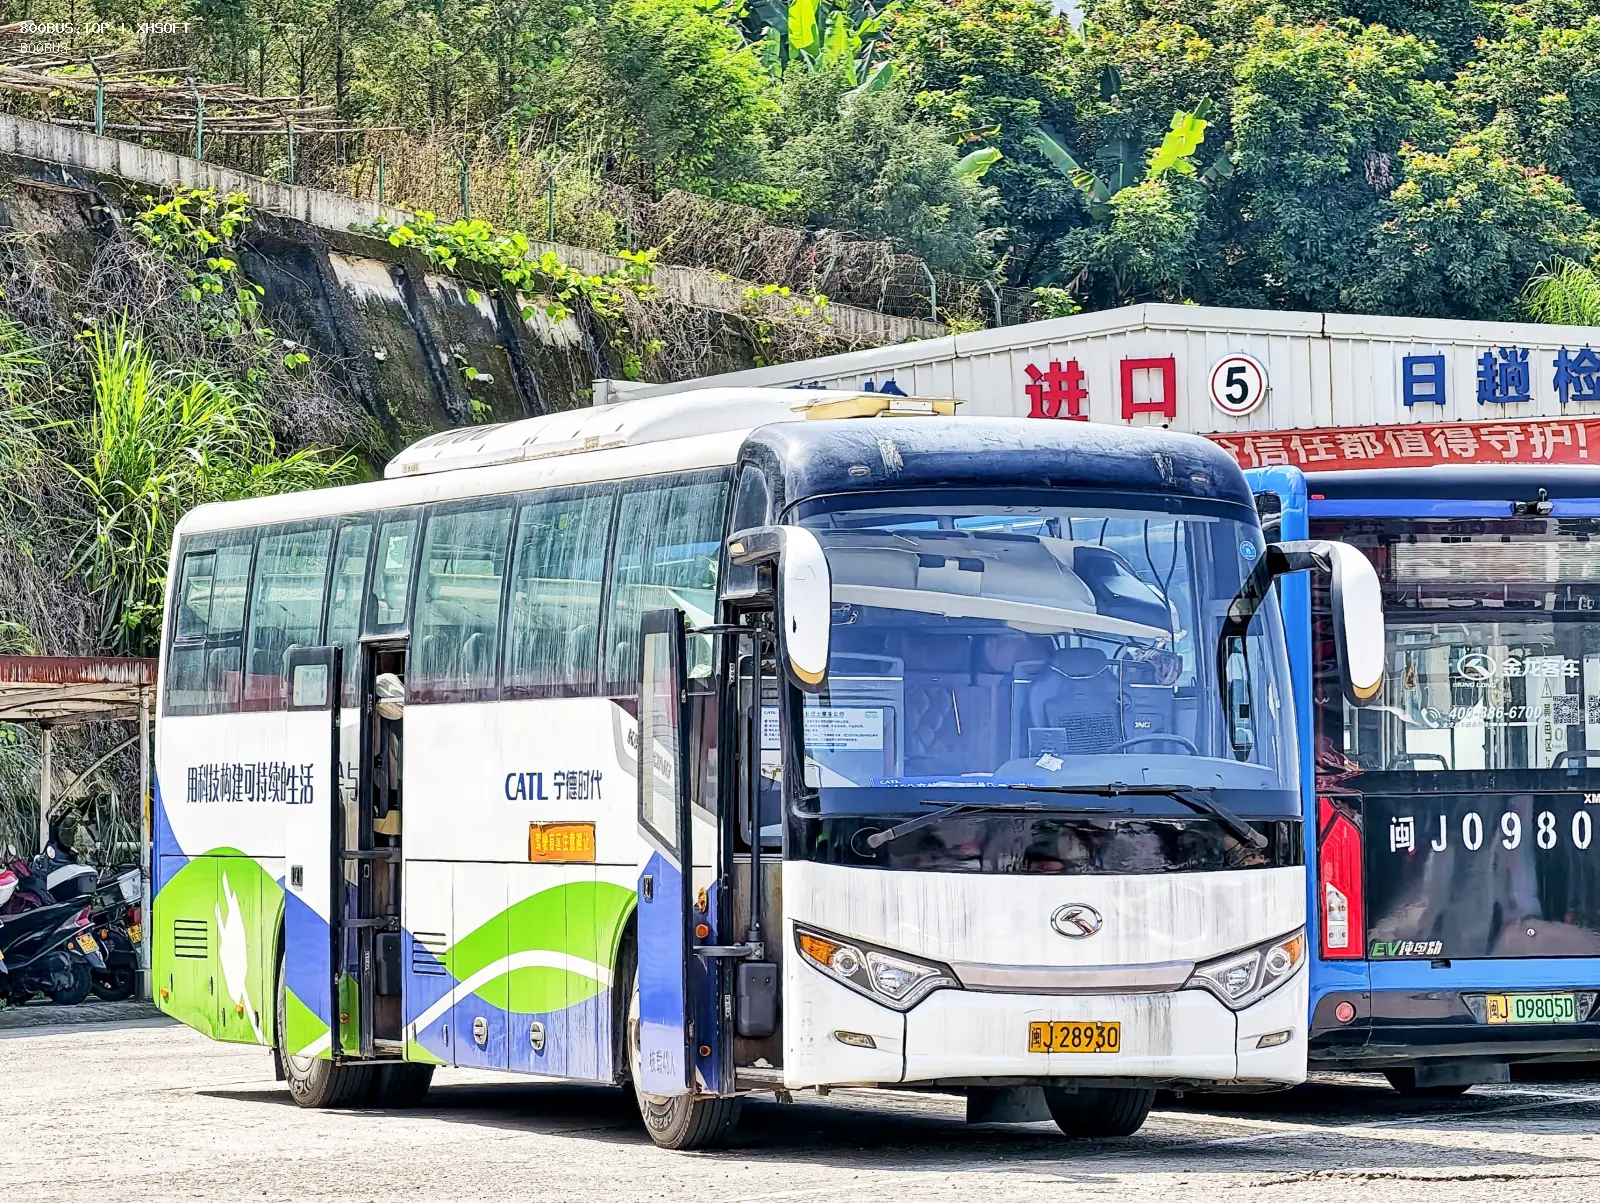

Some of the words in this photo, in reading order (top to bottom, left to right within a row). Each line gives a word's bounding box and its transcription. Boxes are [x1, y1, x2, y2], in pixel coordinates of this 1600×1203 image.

[1024, 357, 1177, 422] 进口
[1225, 365, 1249, 405] 5
[1501, 656, 1581, 679] 金龙客车
[186, 761, 314, 805] 用科技构建可持续的生活
[505, 772, 549, 801] CATL
[553, 769, 603, 801] 宁德时代
